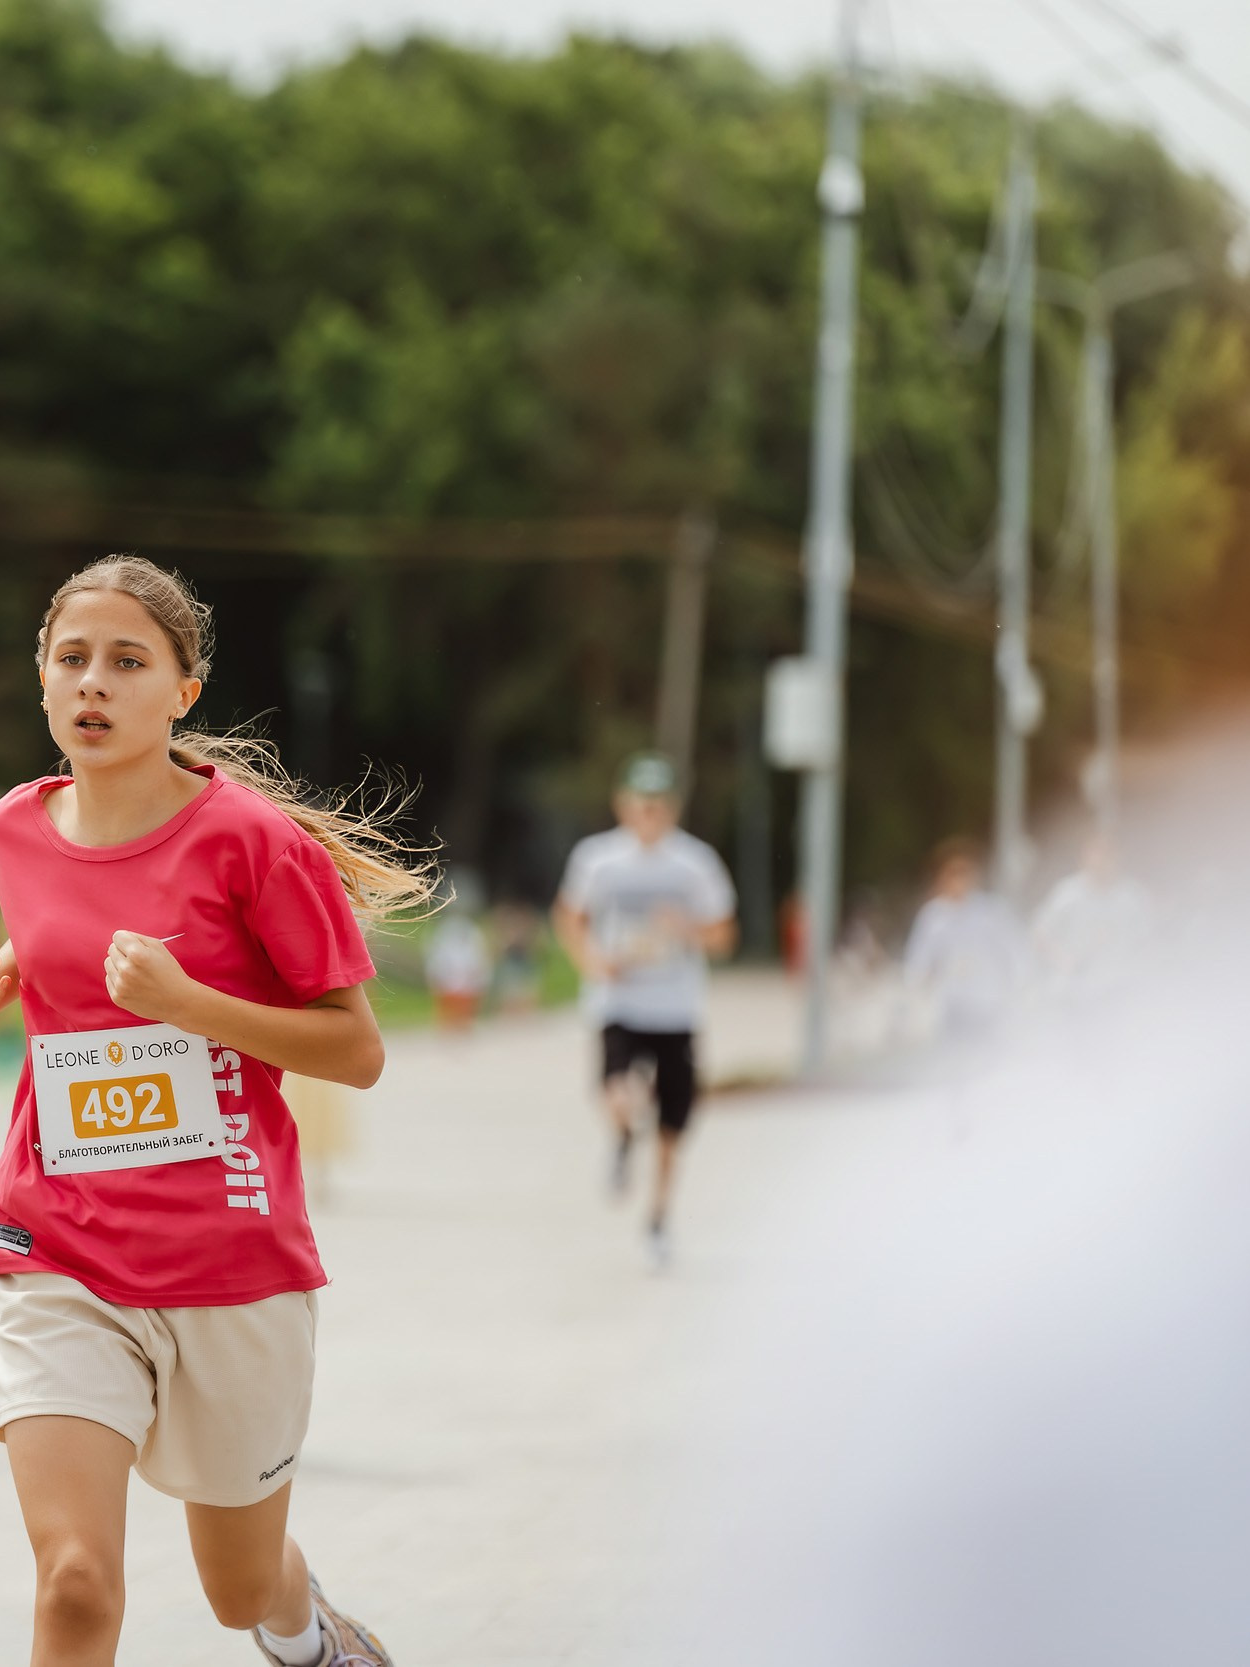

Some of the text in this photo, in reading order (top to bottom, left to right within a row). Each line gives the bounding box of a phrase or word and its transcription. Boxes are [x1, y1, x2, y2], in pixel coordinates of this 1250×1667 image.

[46, 1039, 189, 1069] LEONE D'ORO
[80, 1082, 167, 1130] 492
[58, 1133, 204, 1159] БЛАГОТВОРИТЕЛЬНЫЙ ЗАБЕГ
